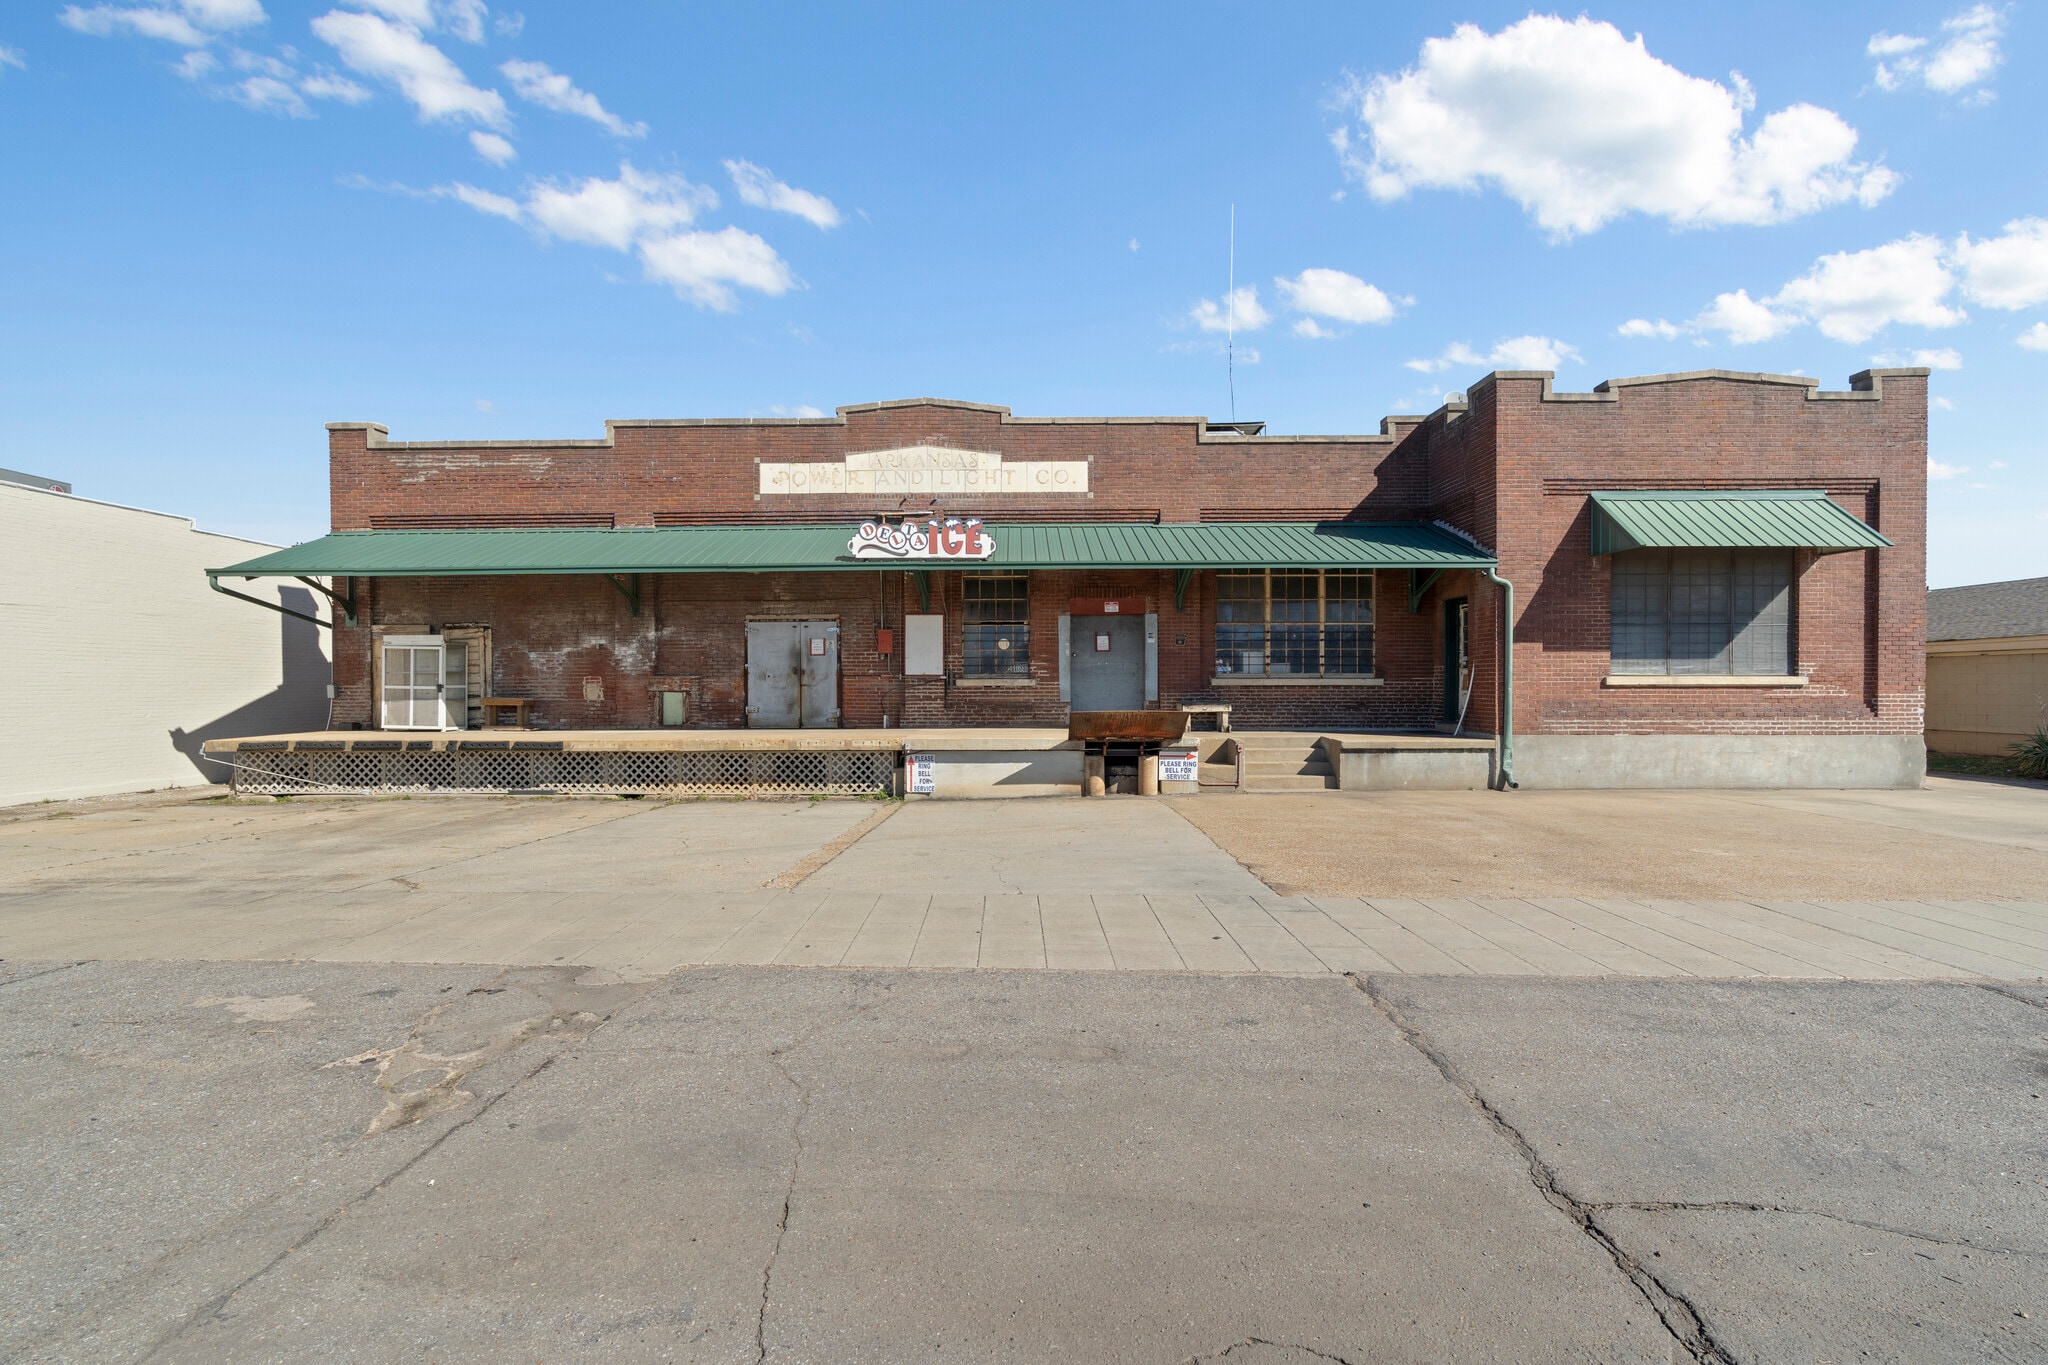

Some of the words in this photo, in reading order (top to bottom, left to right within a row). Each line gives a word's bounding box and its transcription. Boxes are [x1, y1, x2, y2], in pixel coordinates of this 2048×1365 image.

[869, 453, 979, 469] ARKANSAS
[775, 469, 864, 487] POWER
[876, 469, 924, 486] AND
[940, 469, 1016, 486] LIGHT
[1035, 469, 1077, 486] CO.
[860, 522, 927, 549] DELTA
[928, 518, 984, 555] ICE
